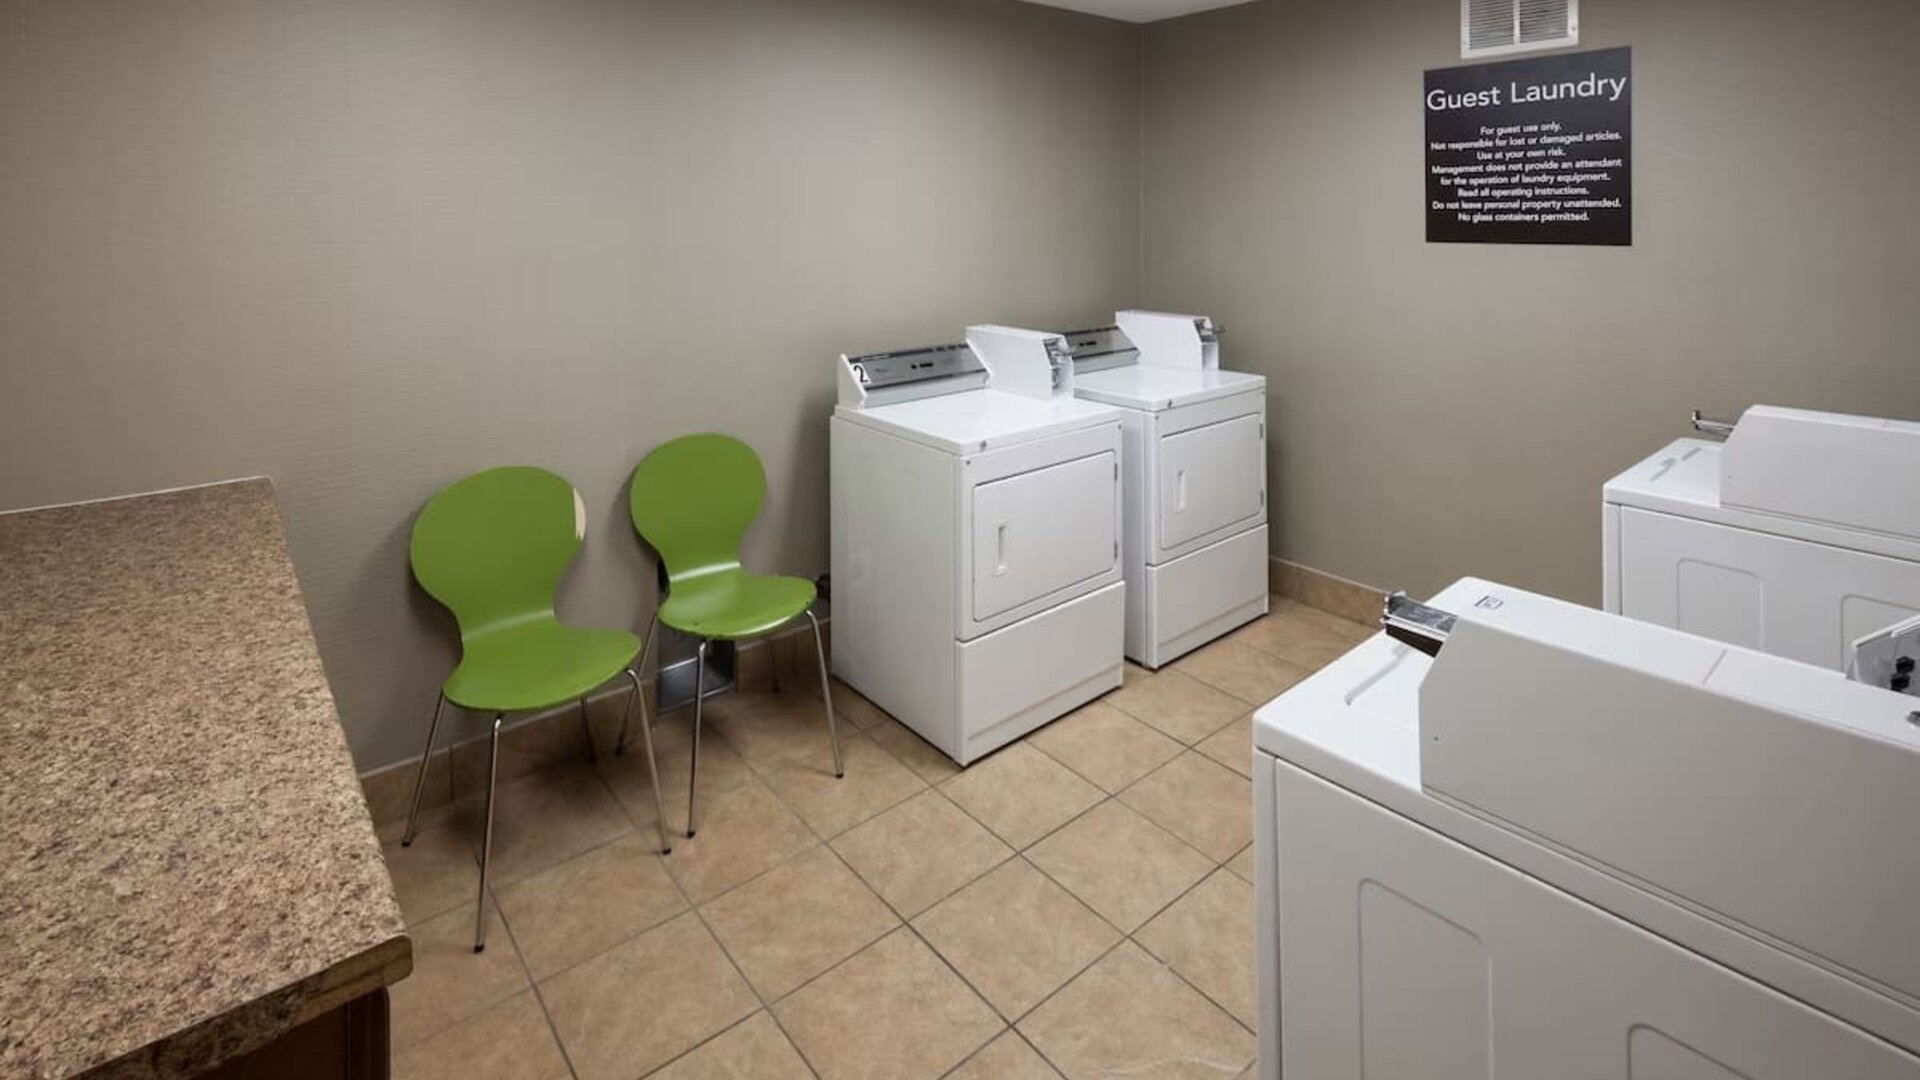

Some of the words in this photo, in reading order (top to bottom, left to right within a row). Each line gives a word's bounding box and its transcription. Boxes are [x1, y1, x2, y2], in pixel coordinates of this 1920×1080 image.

[1427, 87, 1501, 110] Guest
[1511, 72, 1626, 103] Laundry
[1480, 126, 1493, 135] For
[1497, 125, 1520, 135] guest
[1523, 124, 1538, 132] use
[1541, 121, 1561, 132] only.
[1431, 142, 1446, 150] Not
[1448, 139, 1493, 150] responsible
[1510, 137, 1525, 145] lost
[1527, 136, 1537, 144] or
[1539, 132, 1582, 145] damaged
[1586, 130, 1621, 141] articles.
[1477, 151, 1492, 160] Use
[1495, 151, 1503, 159] at
[1505, 151, 1523, 160] your
[1527, 149, 1545, 157] own
[1548, 147, 1566, 156] risk.
[1432, 165, 1483, 175] Management
[1508, 163, 1523, 171] not
[1525, 160, 1559, 172] provide
[1575, 158, 1621, 168] attendant
[1440, 177, 1451, 185] for
[1454, 176, 1467, 185] the
[1469, 175, 1508, 186] operation
[1510, 174, 1519, 183] of
[1522, 173, 1555, 184] laundry
[1557, 172, 1610, 183] equipment.
[1458, 188, 1478, 196] Read
[1480, 188, 1489, 196] all
[1492, 187, 1532, 198] operating
[1535, 186, 1589, 195] instructions.
[1432, 201, 1445, 209] Do
[1447, 201, 1459, 209] not
[1461, 200, 1482, 209] leave
[1484, 199, 1520, 210] personal
[1522, 200, 1561, 210] property
[1564, 198, 1621, 207] unattended.
[1458, 213, 1471, 221] No
[1473, 213, 1493, 223] glass
[1495, 212, 1539, 221] containers
[1541, 212, 1589, 223] permitted.
[853, 365, 869, 383] 2
